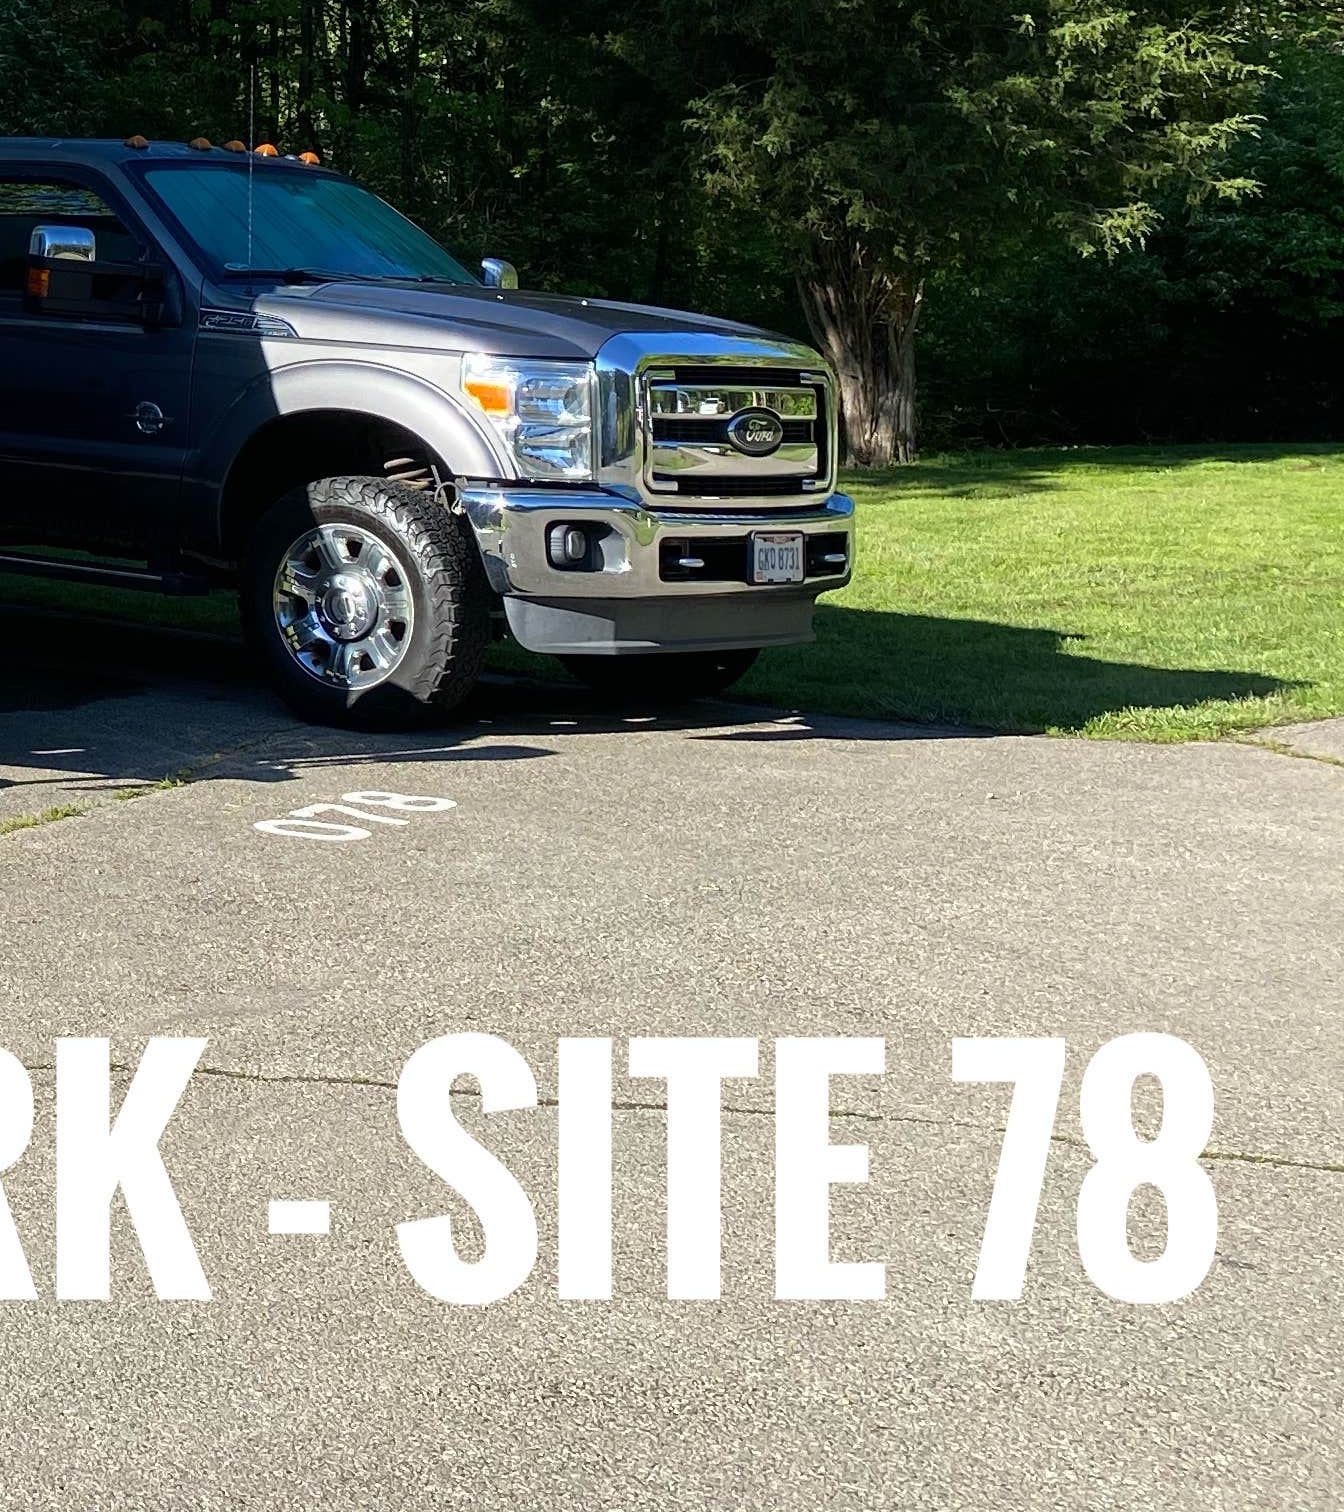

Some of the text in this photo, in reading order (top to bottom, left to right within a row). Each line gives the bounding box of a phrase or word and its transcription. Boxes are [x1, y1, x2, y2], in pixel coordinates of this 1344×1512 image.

[745, 419, 774, 442] Ford
[778, 547, 801, 571] 8731
[253, 790, 459, 841] 078
